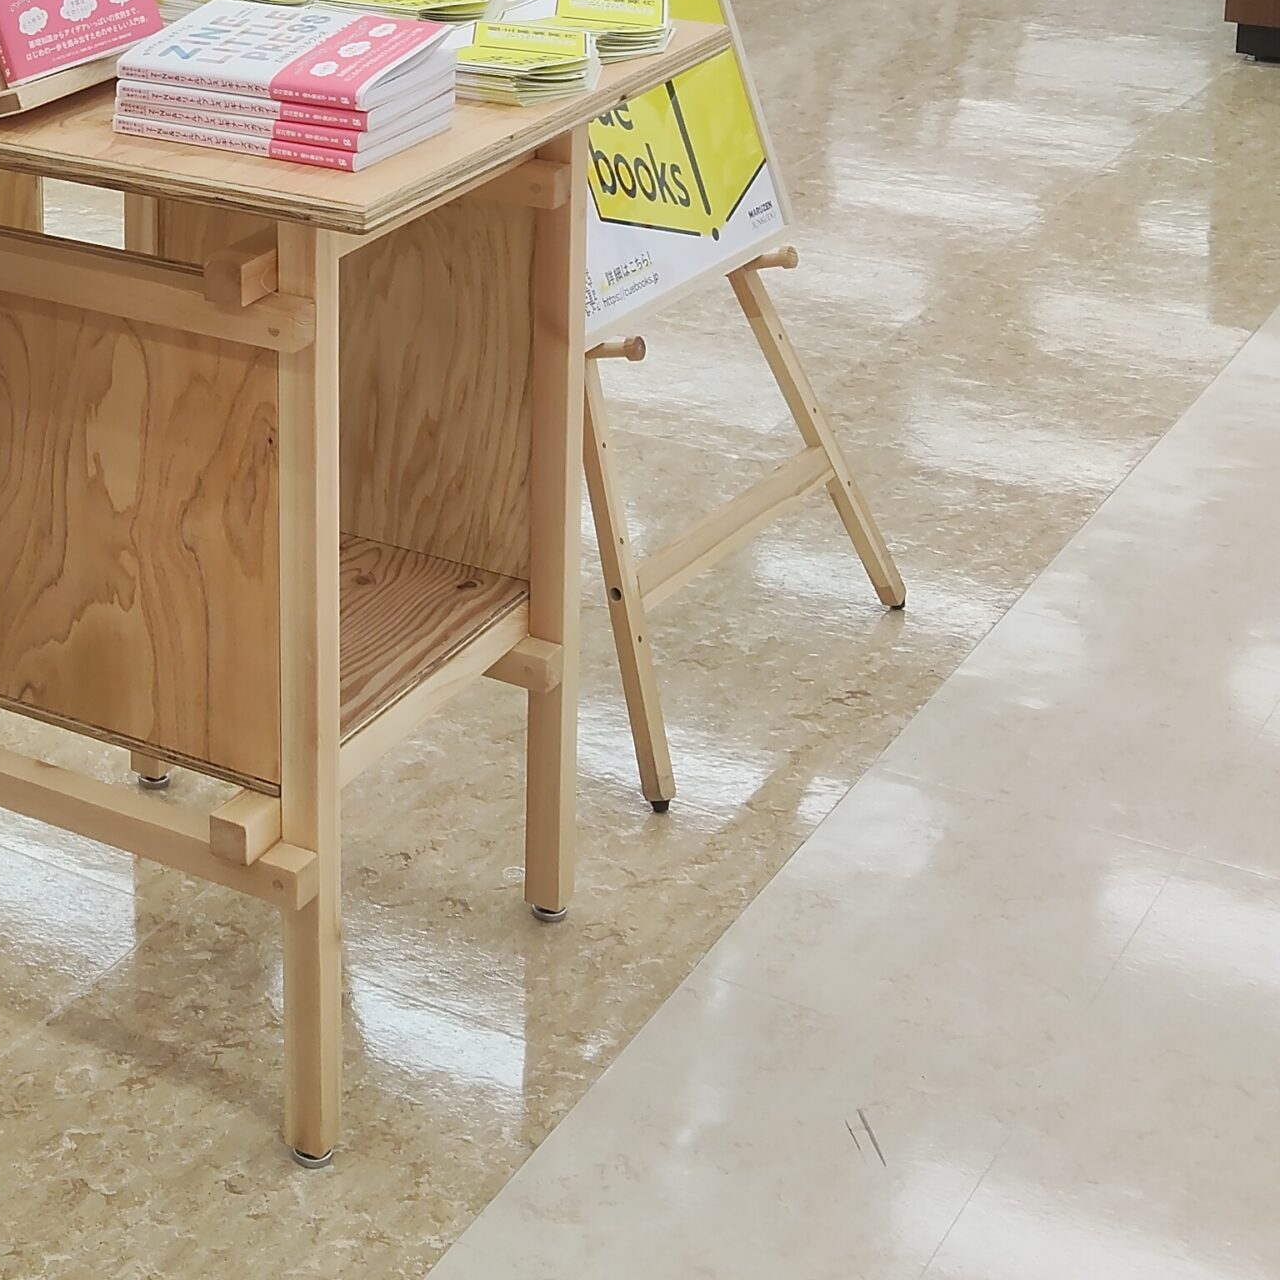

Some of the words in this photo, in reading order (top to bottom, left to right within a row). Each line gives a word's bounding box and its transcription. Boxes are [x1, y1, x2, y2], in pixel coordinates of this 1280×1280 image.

[590, 103, 634, 131] ue
[588, 135, 691, 208] books
[748, 200, 774, 219] MARUZEN
[602, 272, 660, 308] https://cuebooks.jp
